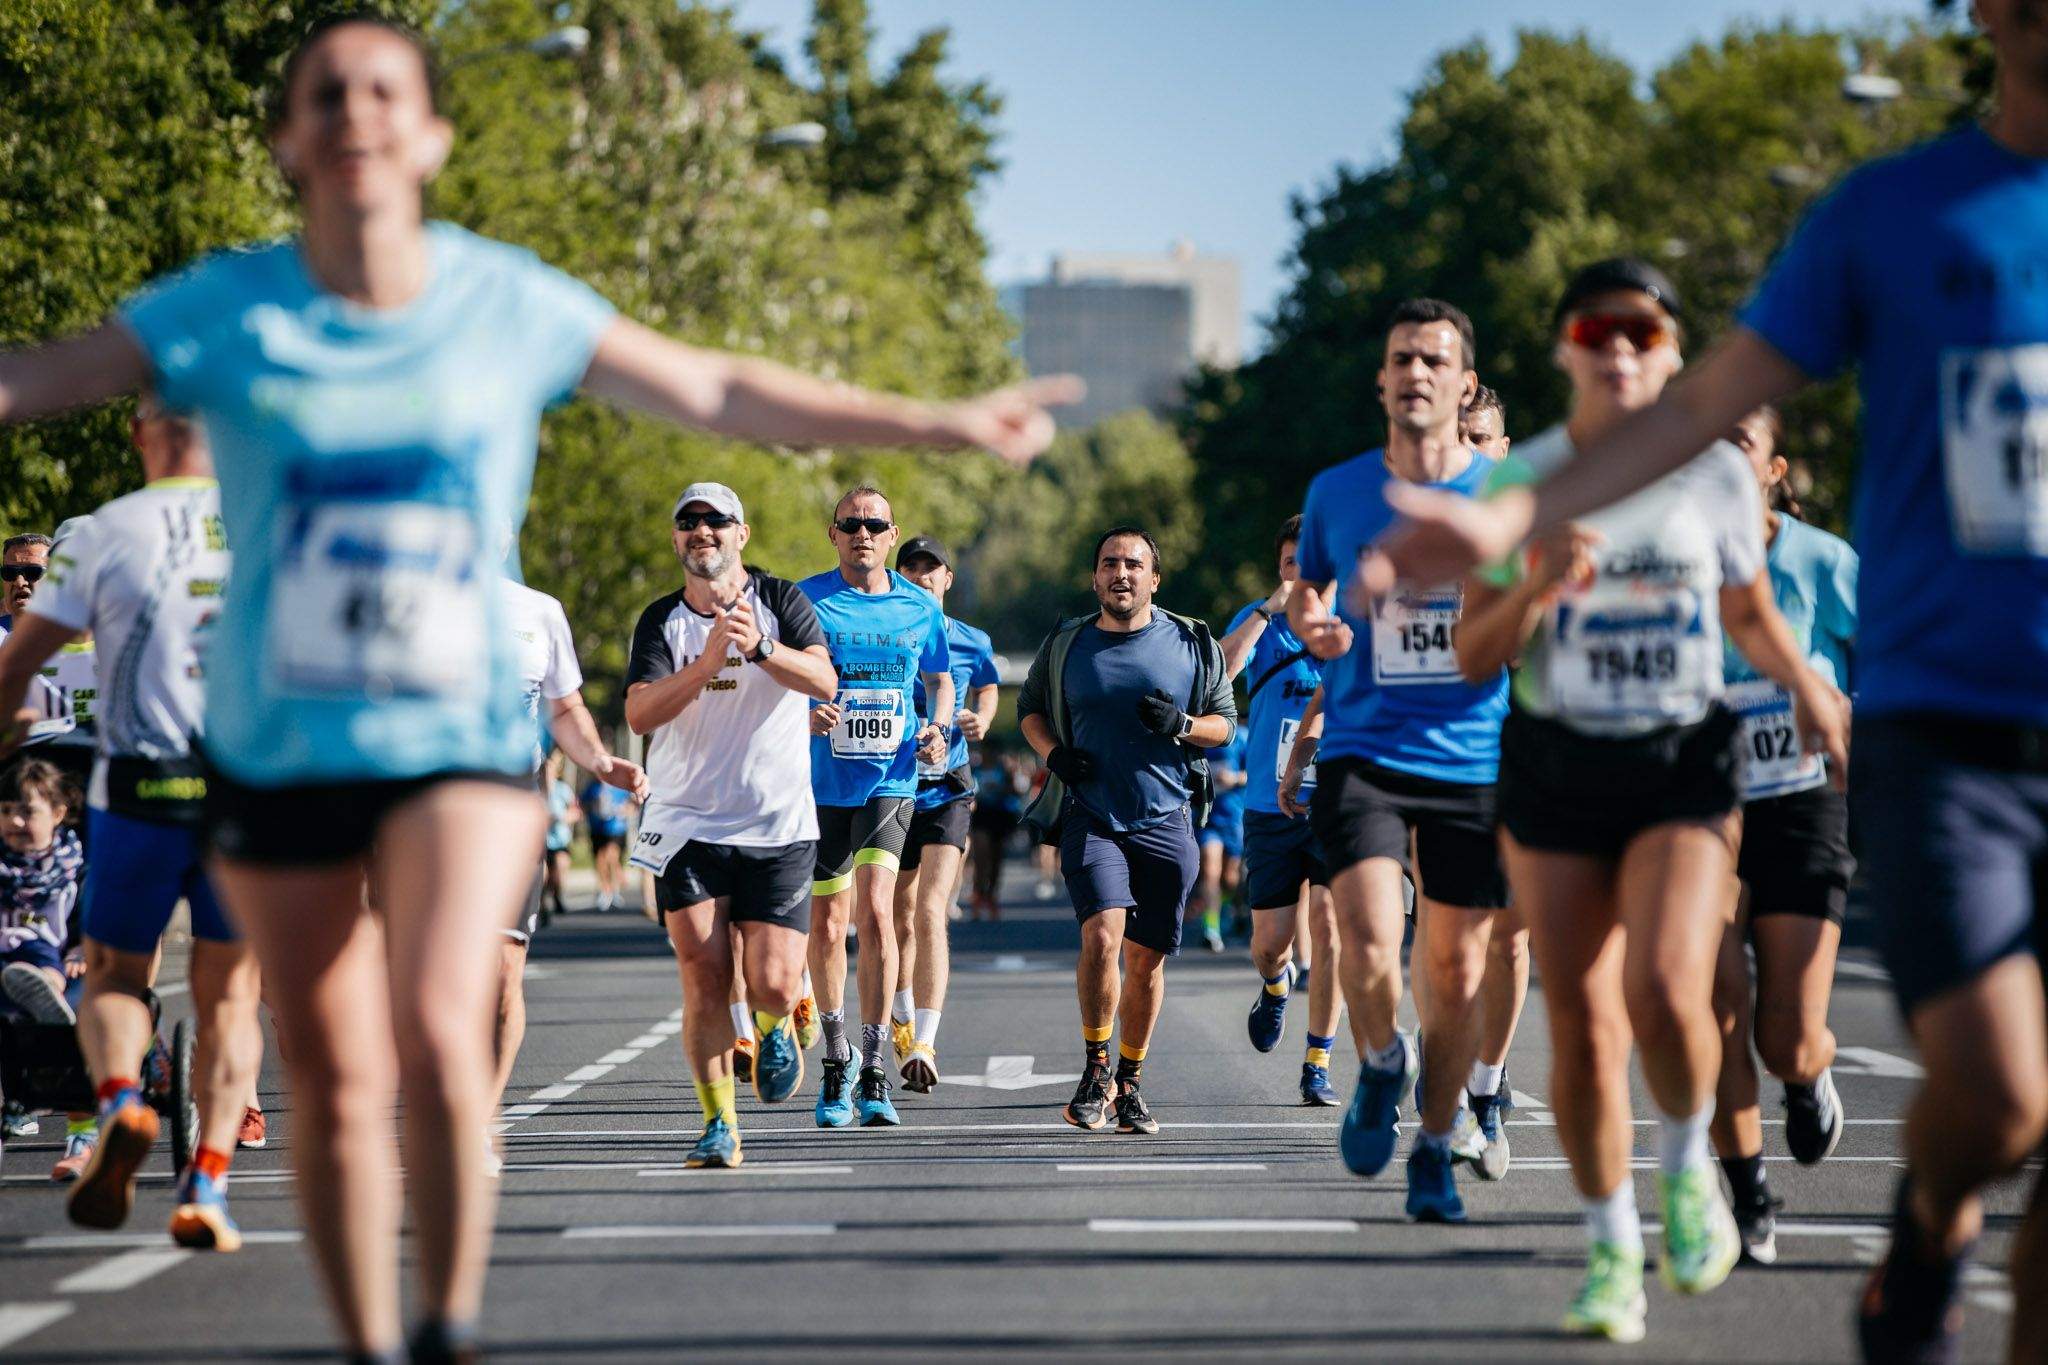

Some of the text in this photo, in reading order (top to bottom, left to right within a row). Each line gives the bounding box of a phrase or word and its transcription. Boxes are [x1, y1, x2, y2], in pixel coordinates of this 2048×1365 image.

[849, 663, 904, 673] BOMBEROS
[870, 671, 879, 680] de
[706, 680, 737, 691] FUEGO
[845, 718, 892, 739] 1099
[1753, 726, 1797, 761] 02
